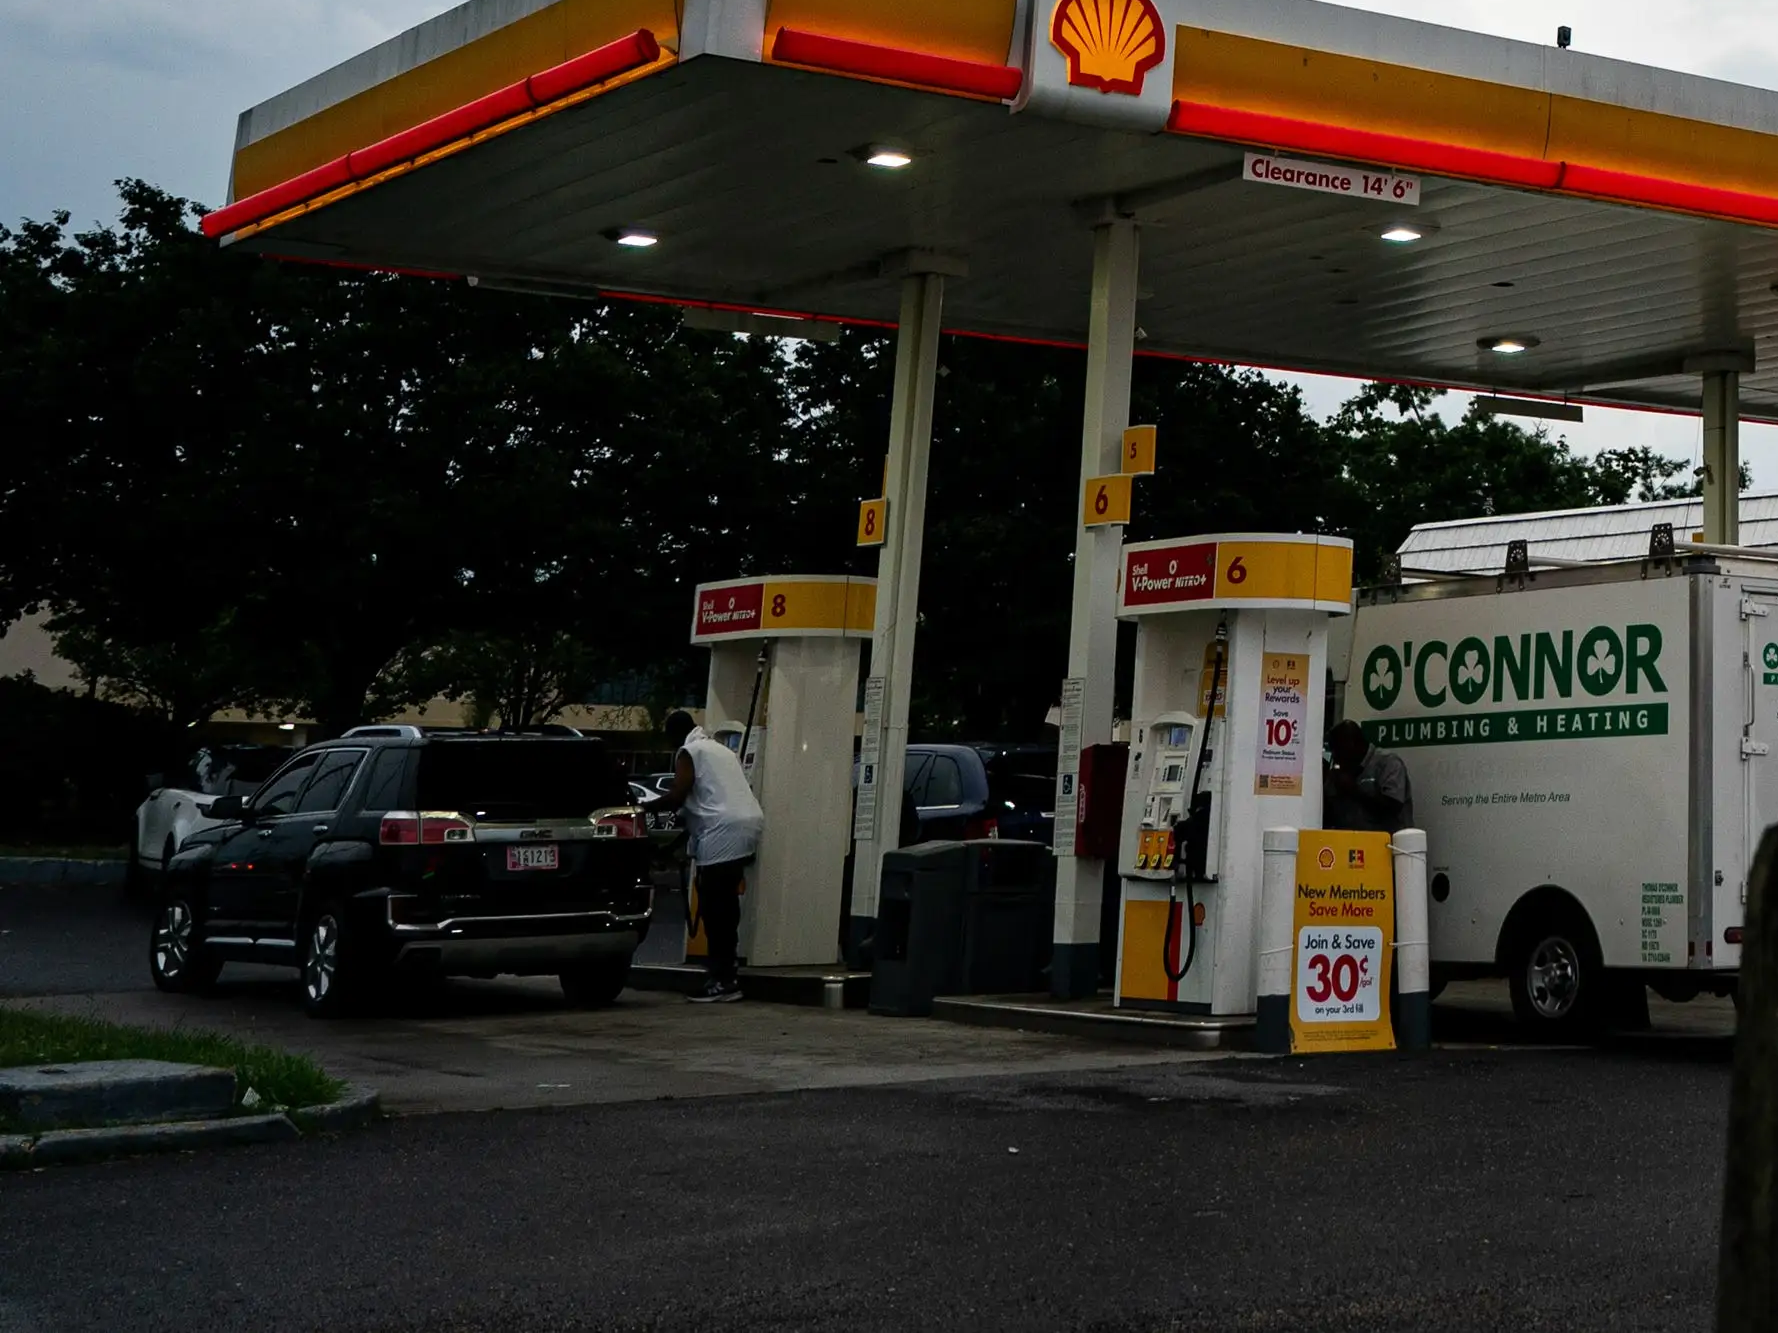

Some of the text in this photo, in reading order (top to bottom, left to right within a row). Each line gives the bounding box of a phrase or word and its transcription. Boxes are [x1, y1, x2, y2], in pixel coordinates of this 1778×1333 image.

[1251, 158, 1351, 191] Clearance
[1130, 442, 1137, 459] 5
[1095, 485, 1108, 515] 6
[864, 508, 876, 536] 8
[1132, 563, 1148, 577] Shell
[1226, 556, 1247, 584] 6
[1132, 576, 1173, 593] V-Power
[771, 593, 786, 617] 8
[1363, 624, 1668, 710] O'CONNOR
[1267, 674, 1300, 687] Level up
[1265, 693, 1300, 703] Rewards
[1273, 686, 1292, 695] your
[1273, 709, 1288, 717] Save
[1378, 710, 1649, 742] PLUMBING & HEATING
[1441, 791, 1571, 807] Serving the Entire Metro Area
[520, 829, 553, 839] GMC
[1298, 883, 1386, 899] New Members
[1309, 902, 1374, 917] Save More
[1305, 934, 1375, 949] Join & Save
[1326, 1006, 1340, 1016] your
[1343, 1004, 1354, 1013] 3rd
[1355, 1003, 1364, 1013] fill
